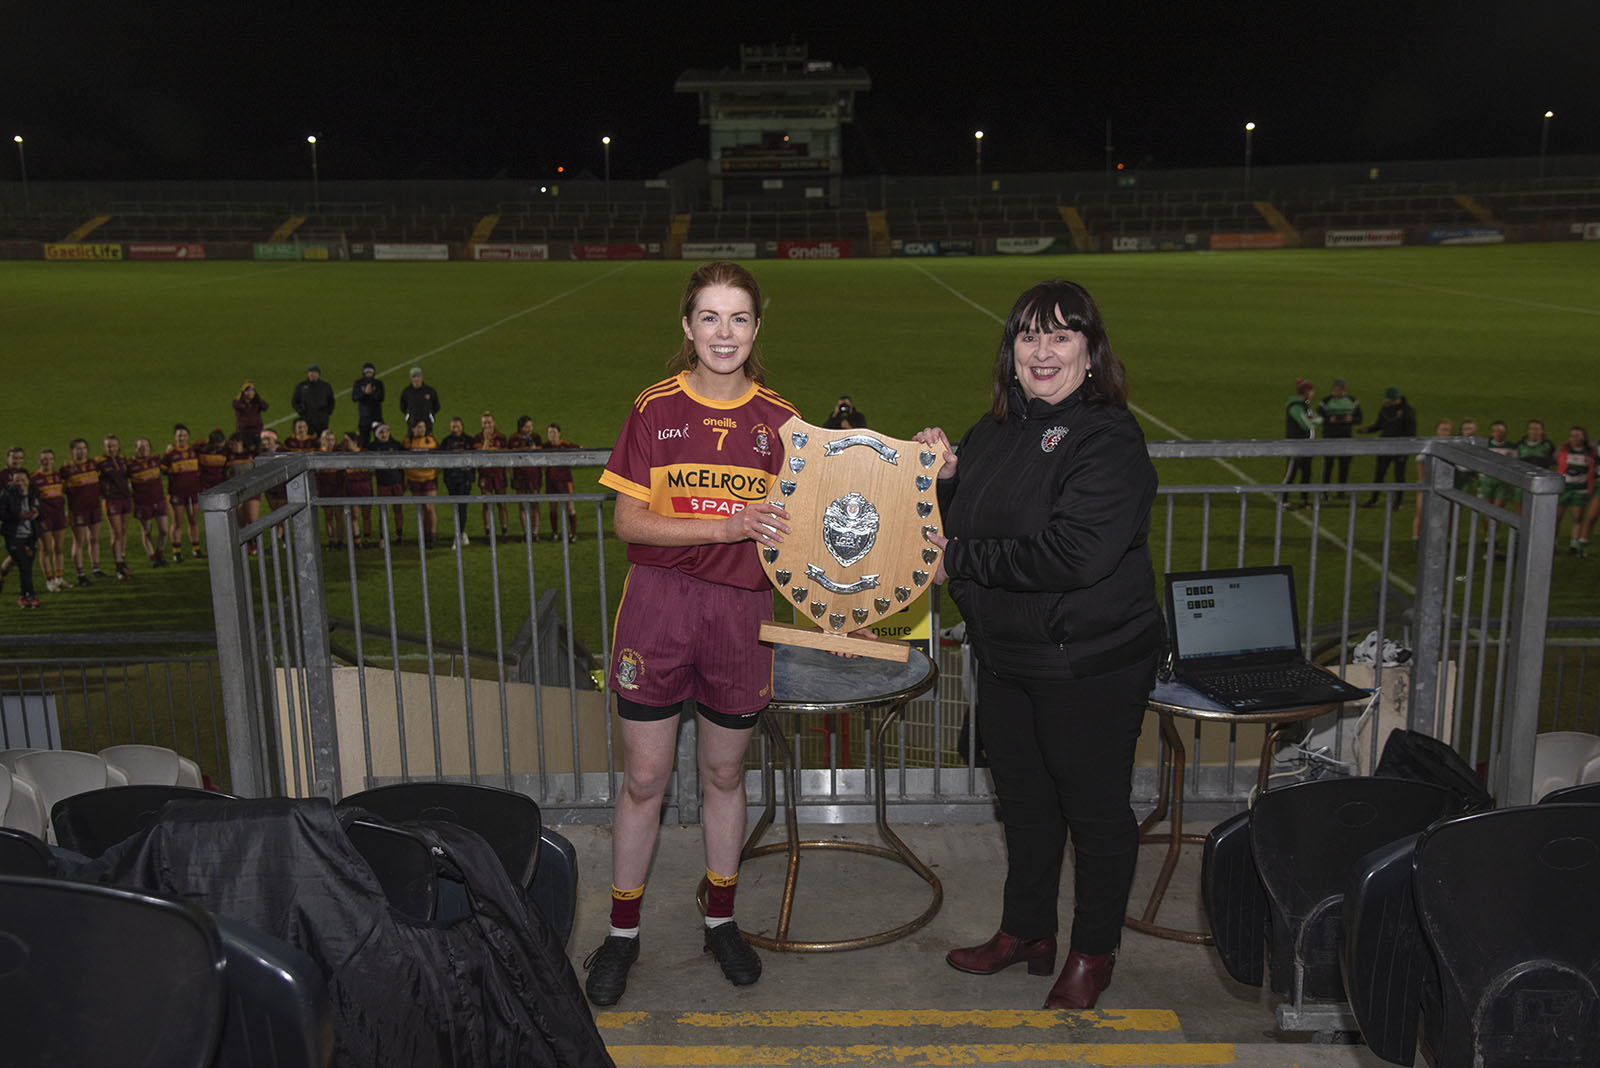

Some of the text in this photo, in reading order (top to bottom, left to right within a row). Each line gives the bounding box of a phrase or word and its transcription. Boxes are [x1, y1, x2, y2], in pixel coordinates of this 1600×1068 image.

[658, 428, 682, 440] LGFA
[712, 428, 728, 451] 7
[872, 626, 911, 637] nsure
